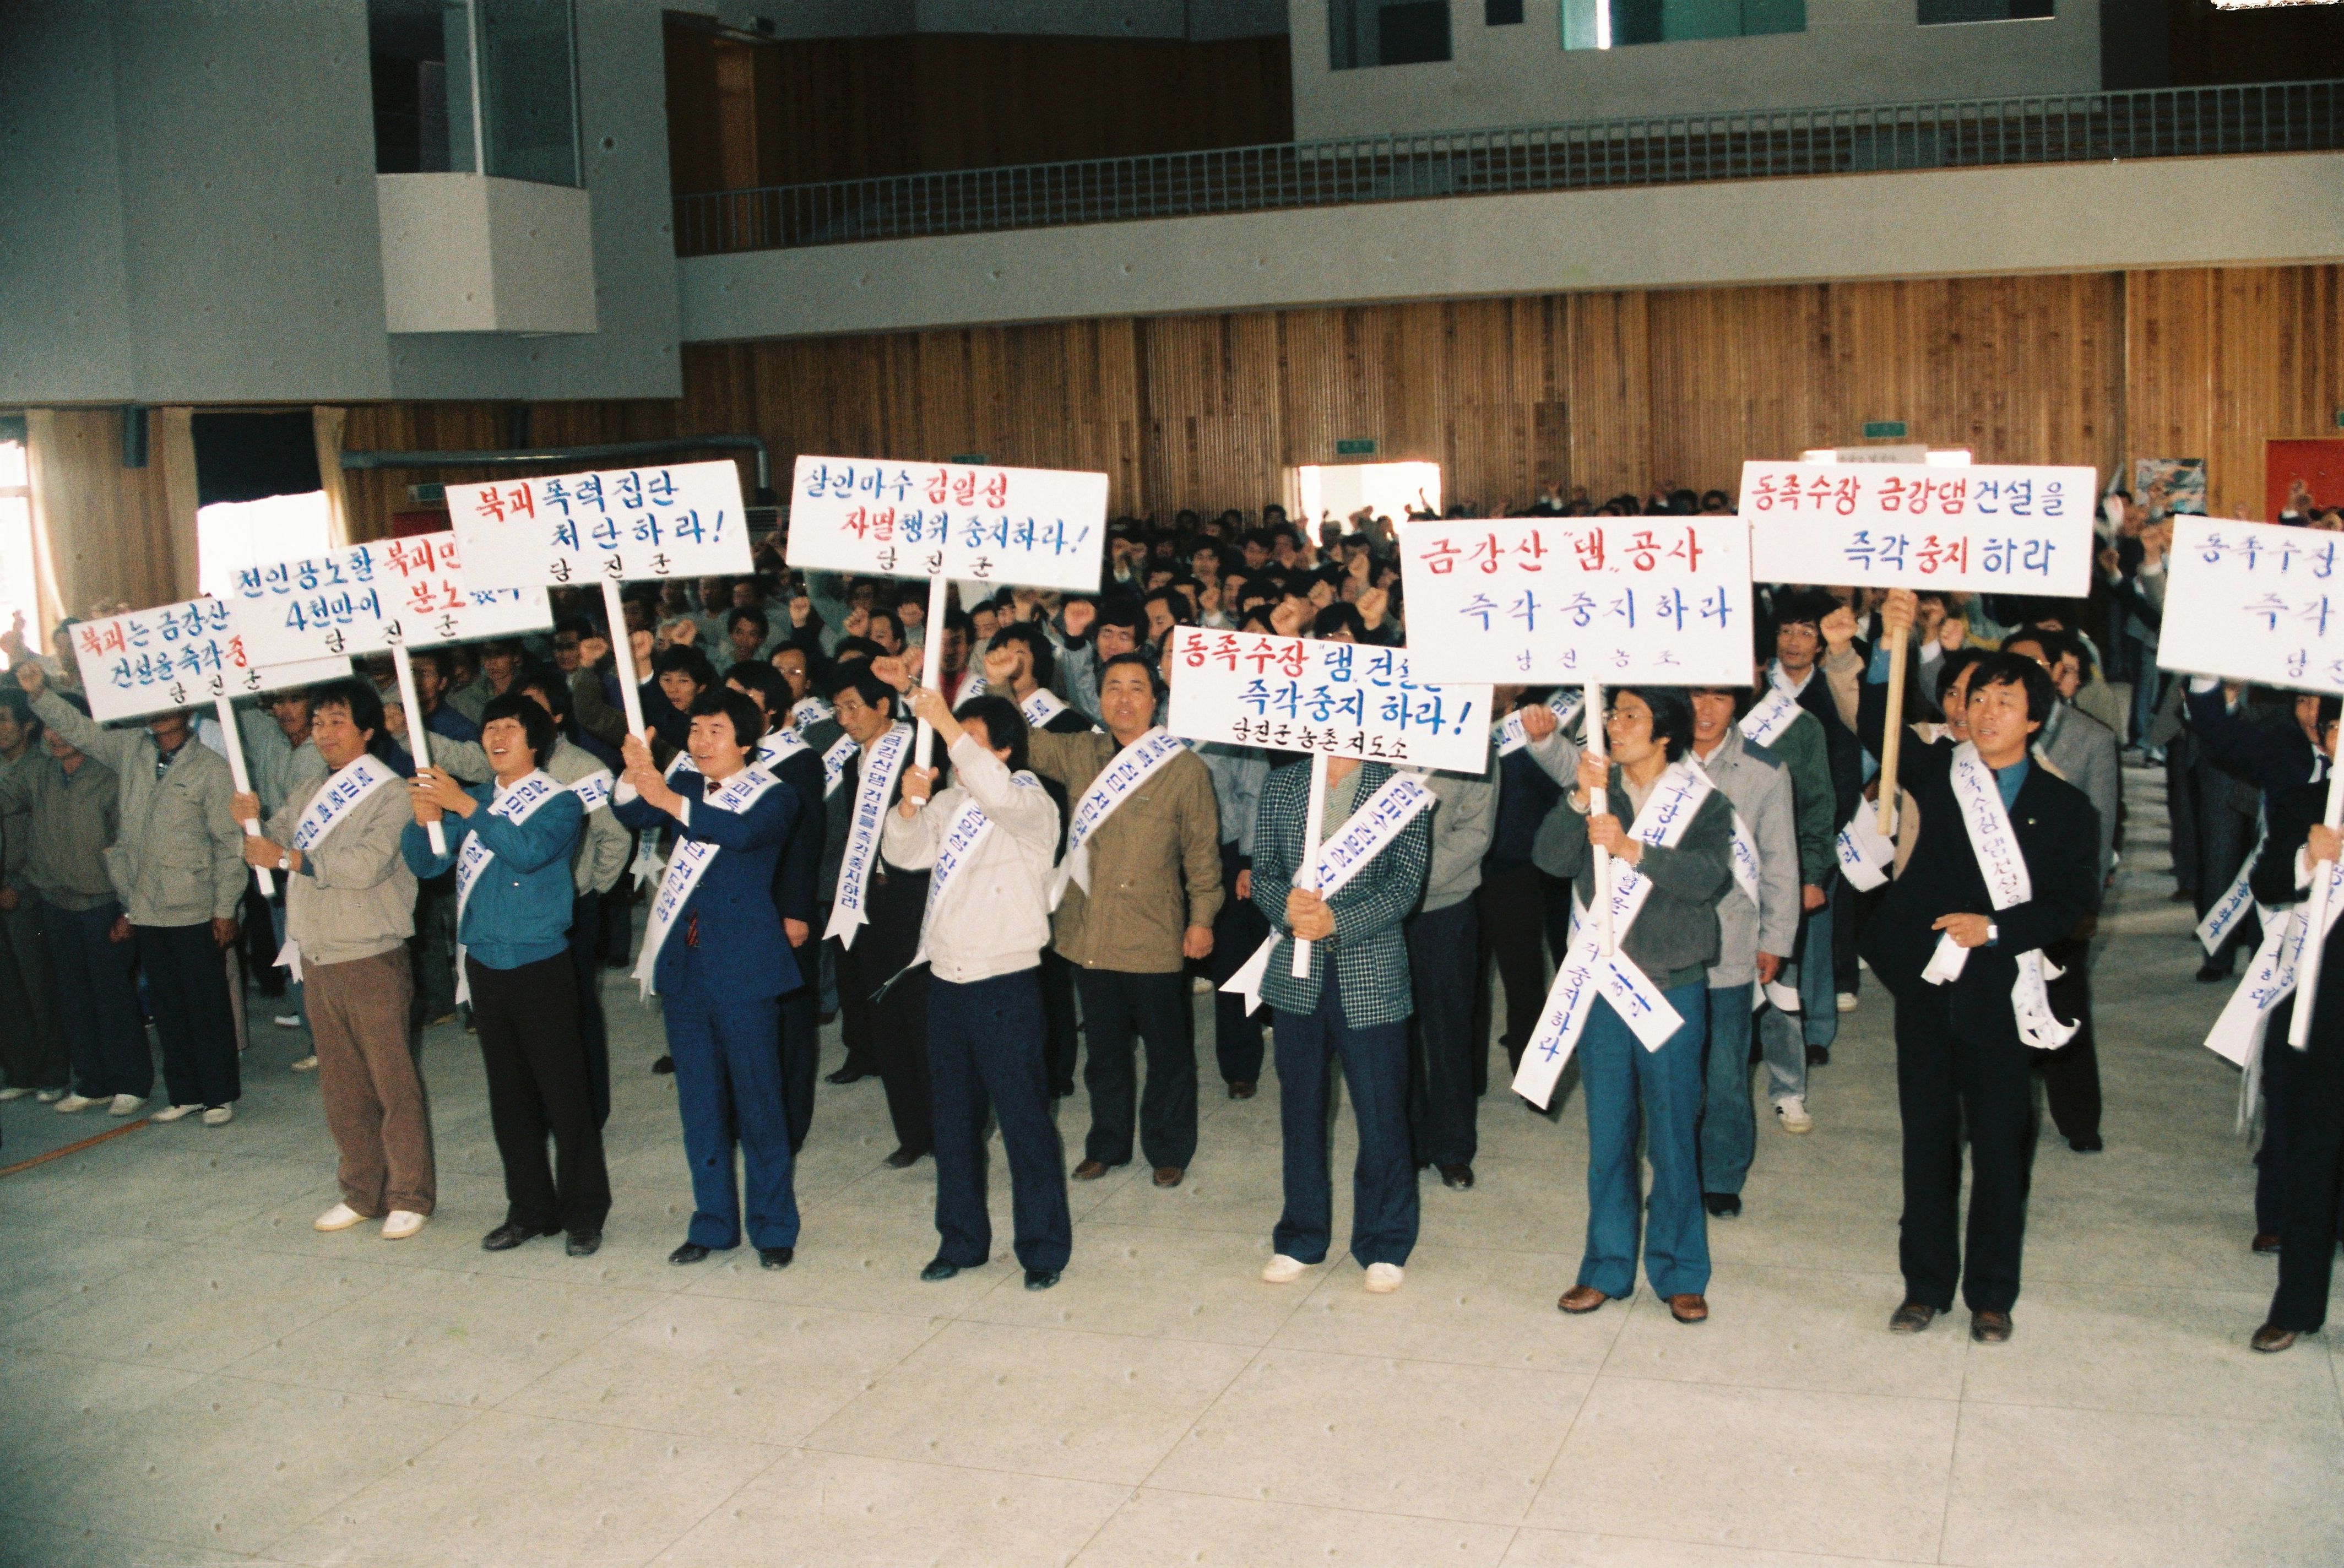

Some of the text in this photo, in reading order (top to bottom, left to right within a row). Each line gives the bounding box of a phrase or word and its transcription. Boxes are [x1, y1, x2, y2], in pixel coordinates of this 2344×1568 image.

[475, 481, 535, 523] 북괴
[801, 464, 1007, 509] 살인마수 김일성
[1752, 473, 1862, 517] 동족수장
[1876, 475, 1967, 516] 금강댐
[237, 545, 376, 598] 천인공노할
[1419, 529, 1549, 575] 금강산
[1623, 525, 1703, 573] 공사
[80, 600, 230, 657] 북괴는 금강산
[1459, 588, 1542, 632] 즉각
[2242, 594, 2336, 637] 즉각
[1179, 633, 1310, 678] 동족수장
[1374, 780, 1425, 831] 살인마수
